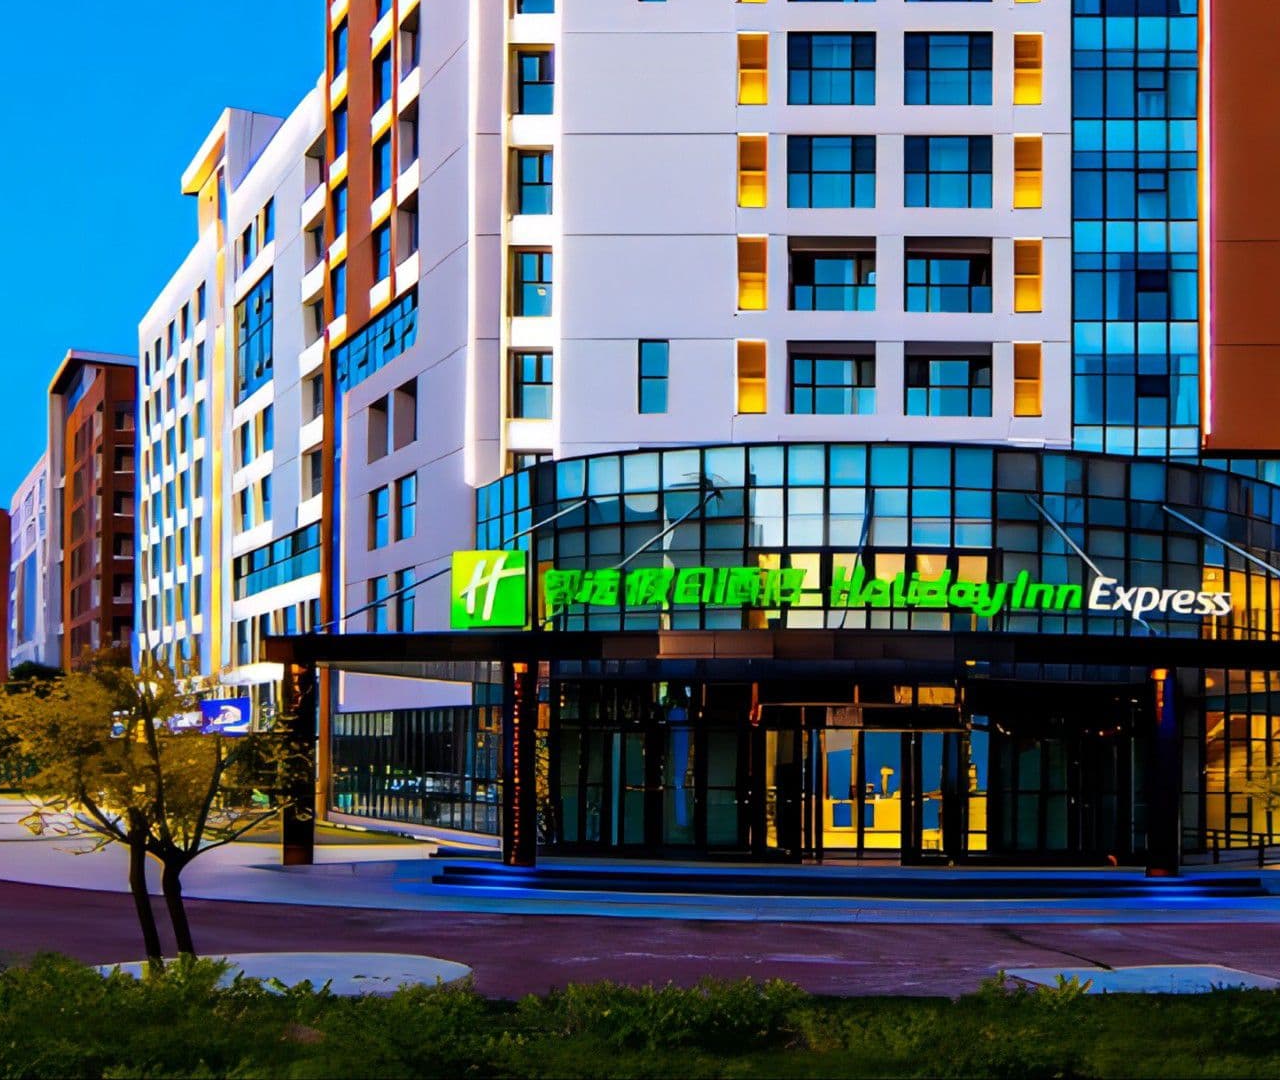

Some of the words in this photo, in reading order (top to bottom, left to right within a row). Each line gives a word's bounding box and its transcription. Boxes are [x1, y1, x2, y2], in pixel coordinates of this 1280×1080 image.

[459, 555, 526, 621] H
[829, 566, 1006, 617] Holiday
[1010, 570, 1081, 609] Inn
[1088, 576, 1232, 619] Express
